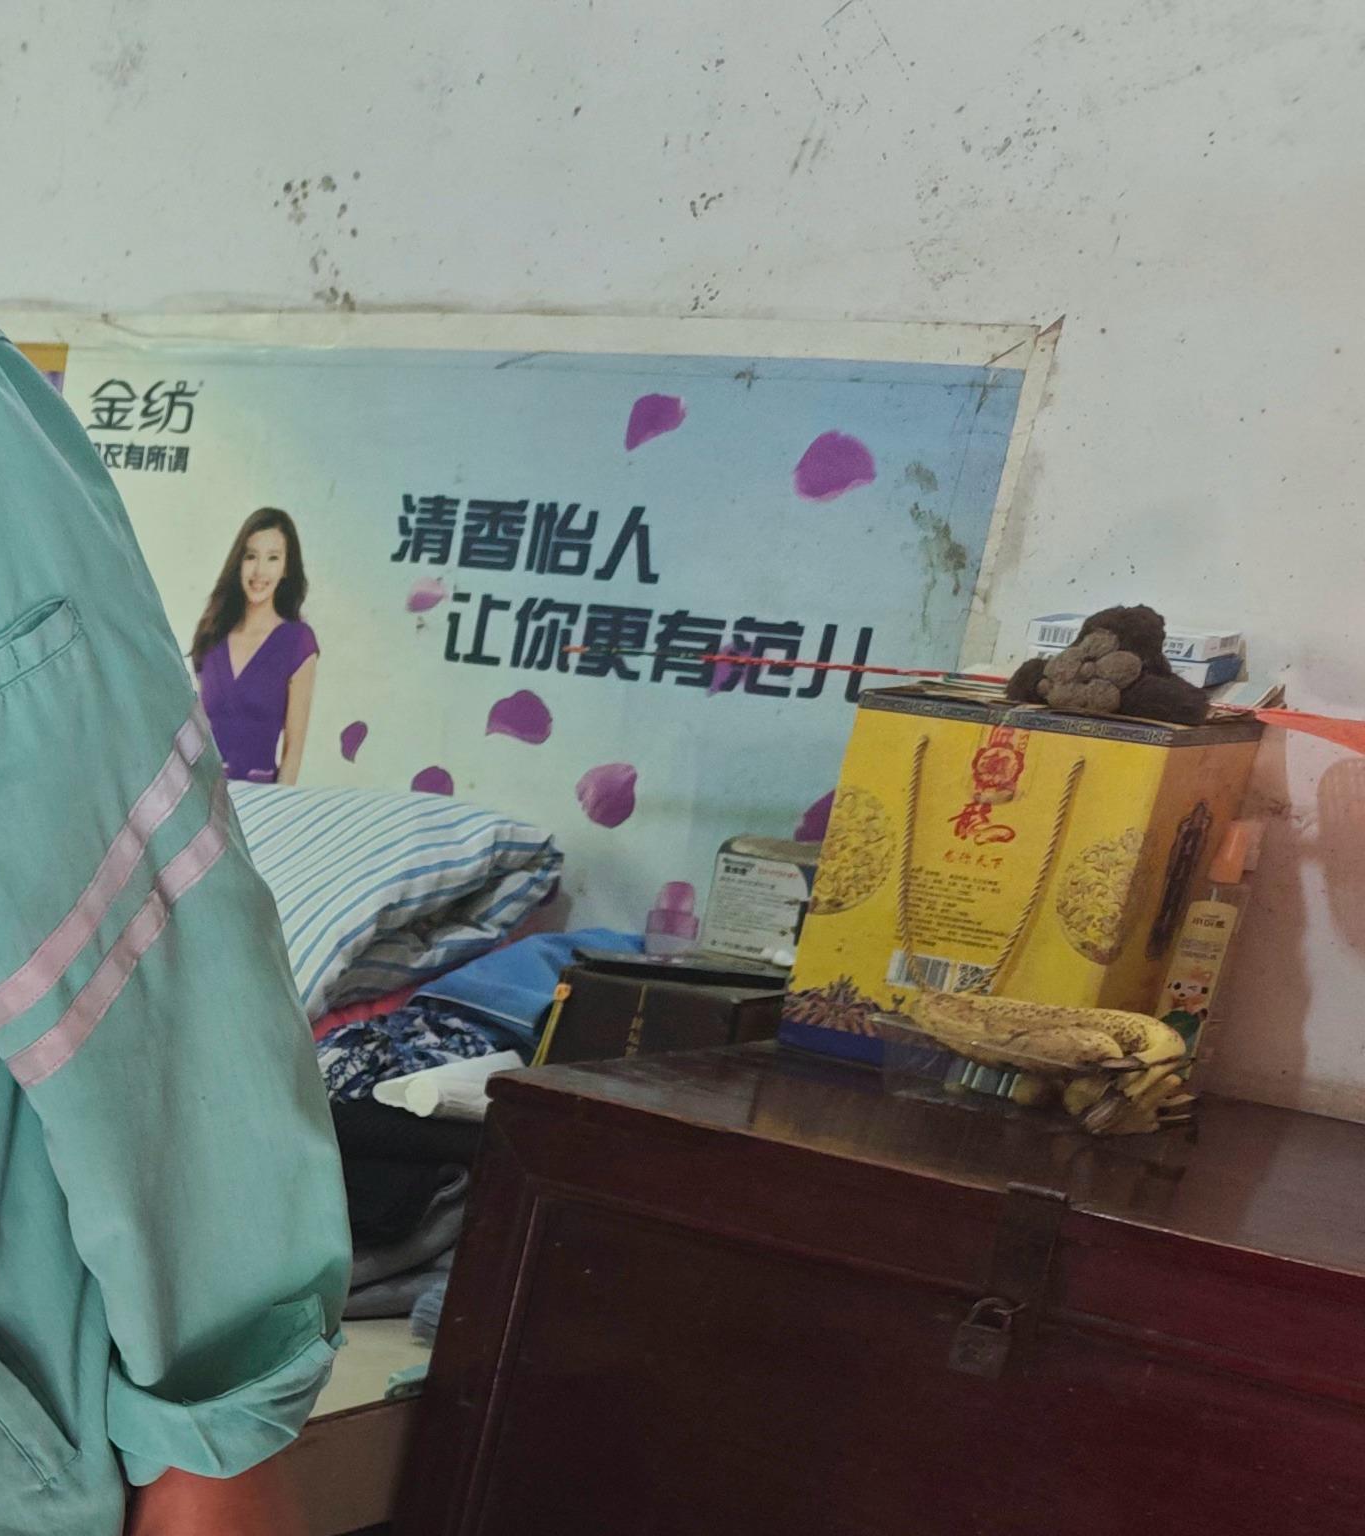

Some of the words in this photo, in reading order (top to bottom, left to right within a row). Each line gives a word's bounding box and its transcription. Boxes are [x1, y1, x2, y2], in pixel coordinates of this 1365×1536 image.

[85, 378, 199, 434] 金纺
[389, 493, 660, 585] 清香怡人
[444, 591, 874, 703] 让你更有范儿
